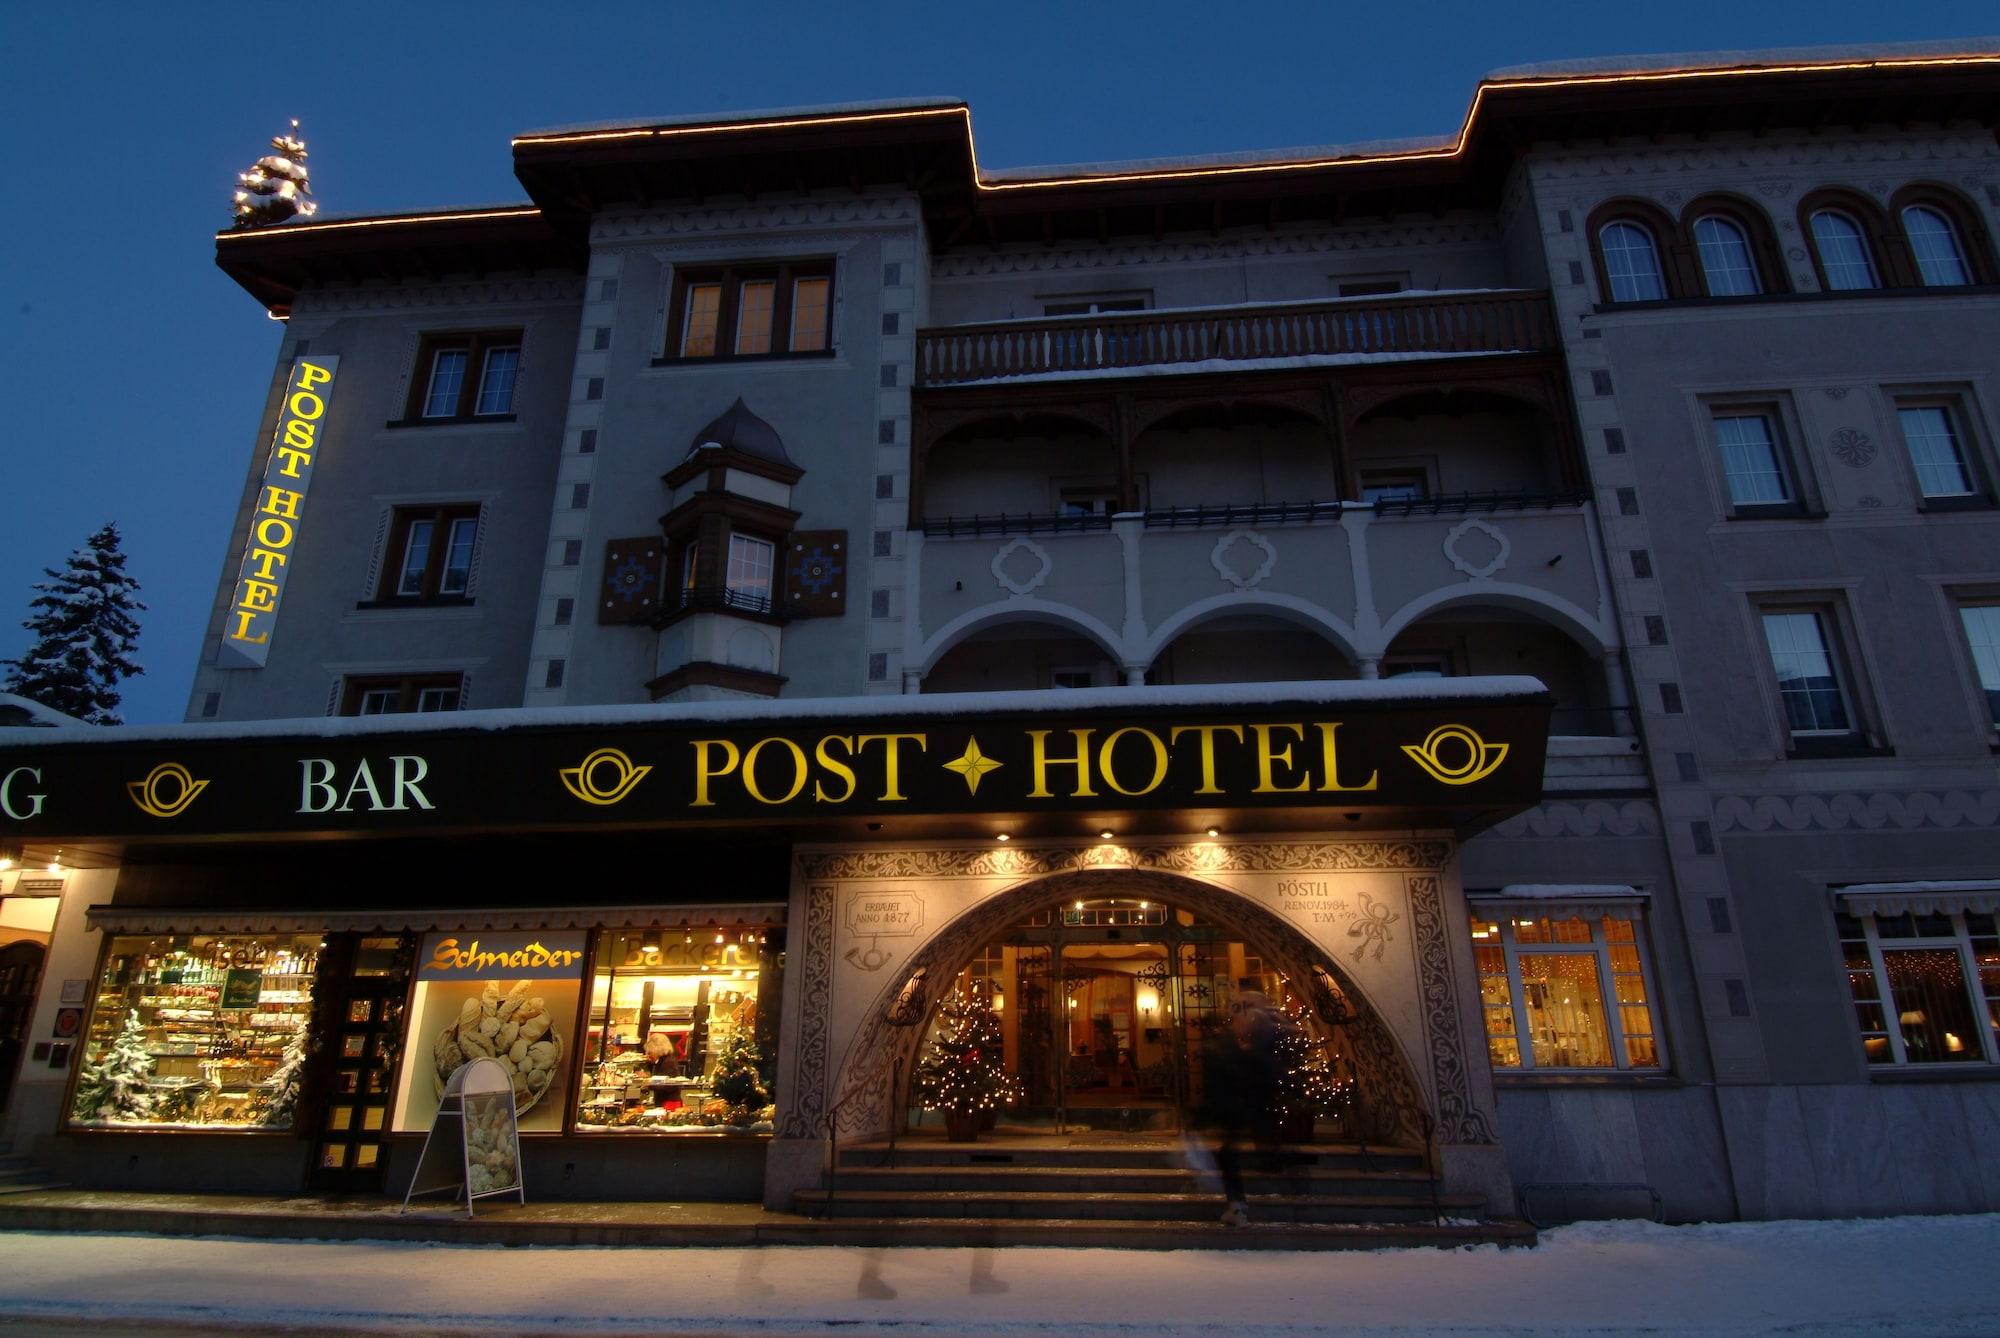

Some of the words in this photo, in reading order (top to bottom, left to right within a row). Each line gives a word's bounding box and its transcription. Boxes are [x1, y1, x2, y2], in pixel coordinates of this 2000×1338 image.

[277, 362, 332, 478] POST
[230, 485, 305, 644] HOTEL
[296, 755, 436, 813] BAR
[688, 732, 927, 807] POST
[1023, 721, 1379, 799] HOTEL
[1277, 879, 1328, 897] PÖSTLI
[856, 913, 880, 923] ANNO
[885, 912, 910, 923] 1877
[422, 938, 583, 973] Schneider
